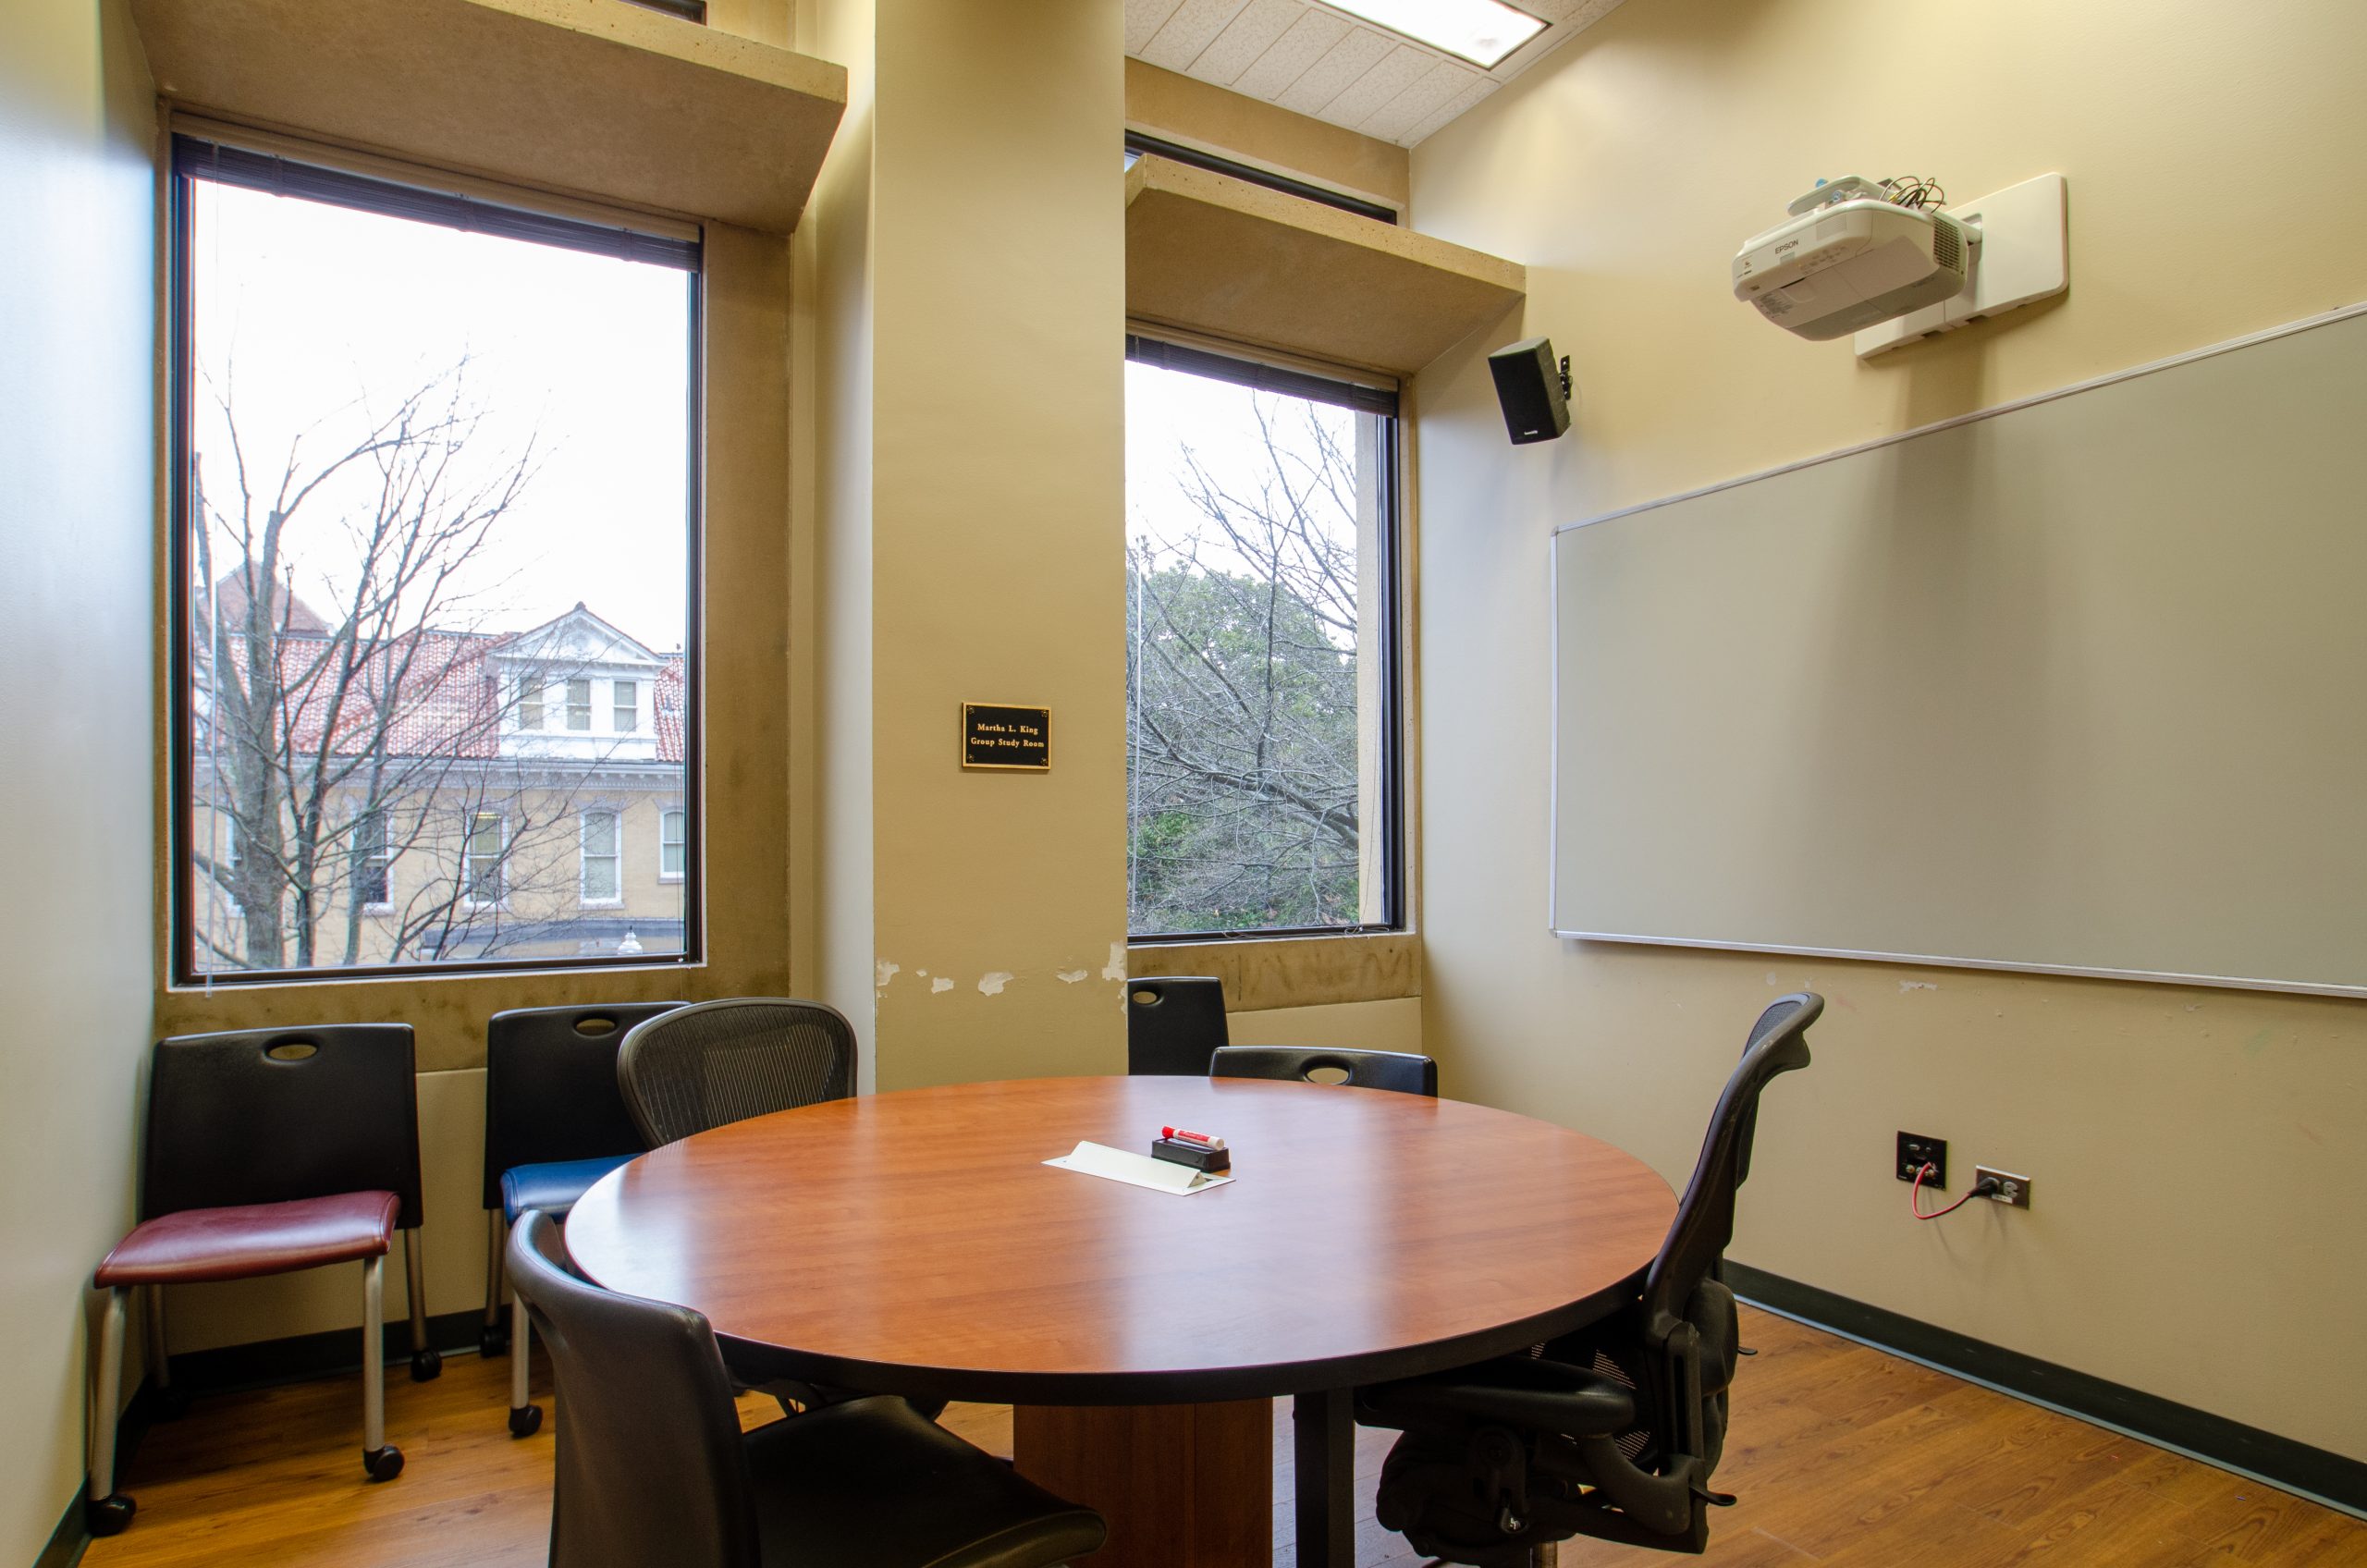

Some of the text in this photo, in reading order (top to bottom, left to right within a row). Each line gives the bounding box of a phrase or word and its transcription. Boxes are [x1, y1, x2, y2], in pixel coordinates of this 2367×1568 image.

[1774, 239, 1798, 254] EPSON
[977, 723, 1005, 732] Martha
[1020, 726, 1038, 735] King
[971, 737, 1045, 748] Group Study Room
